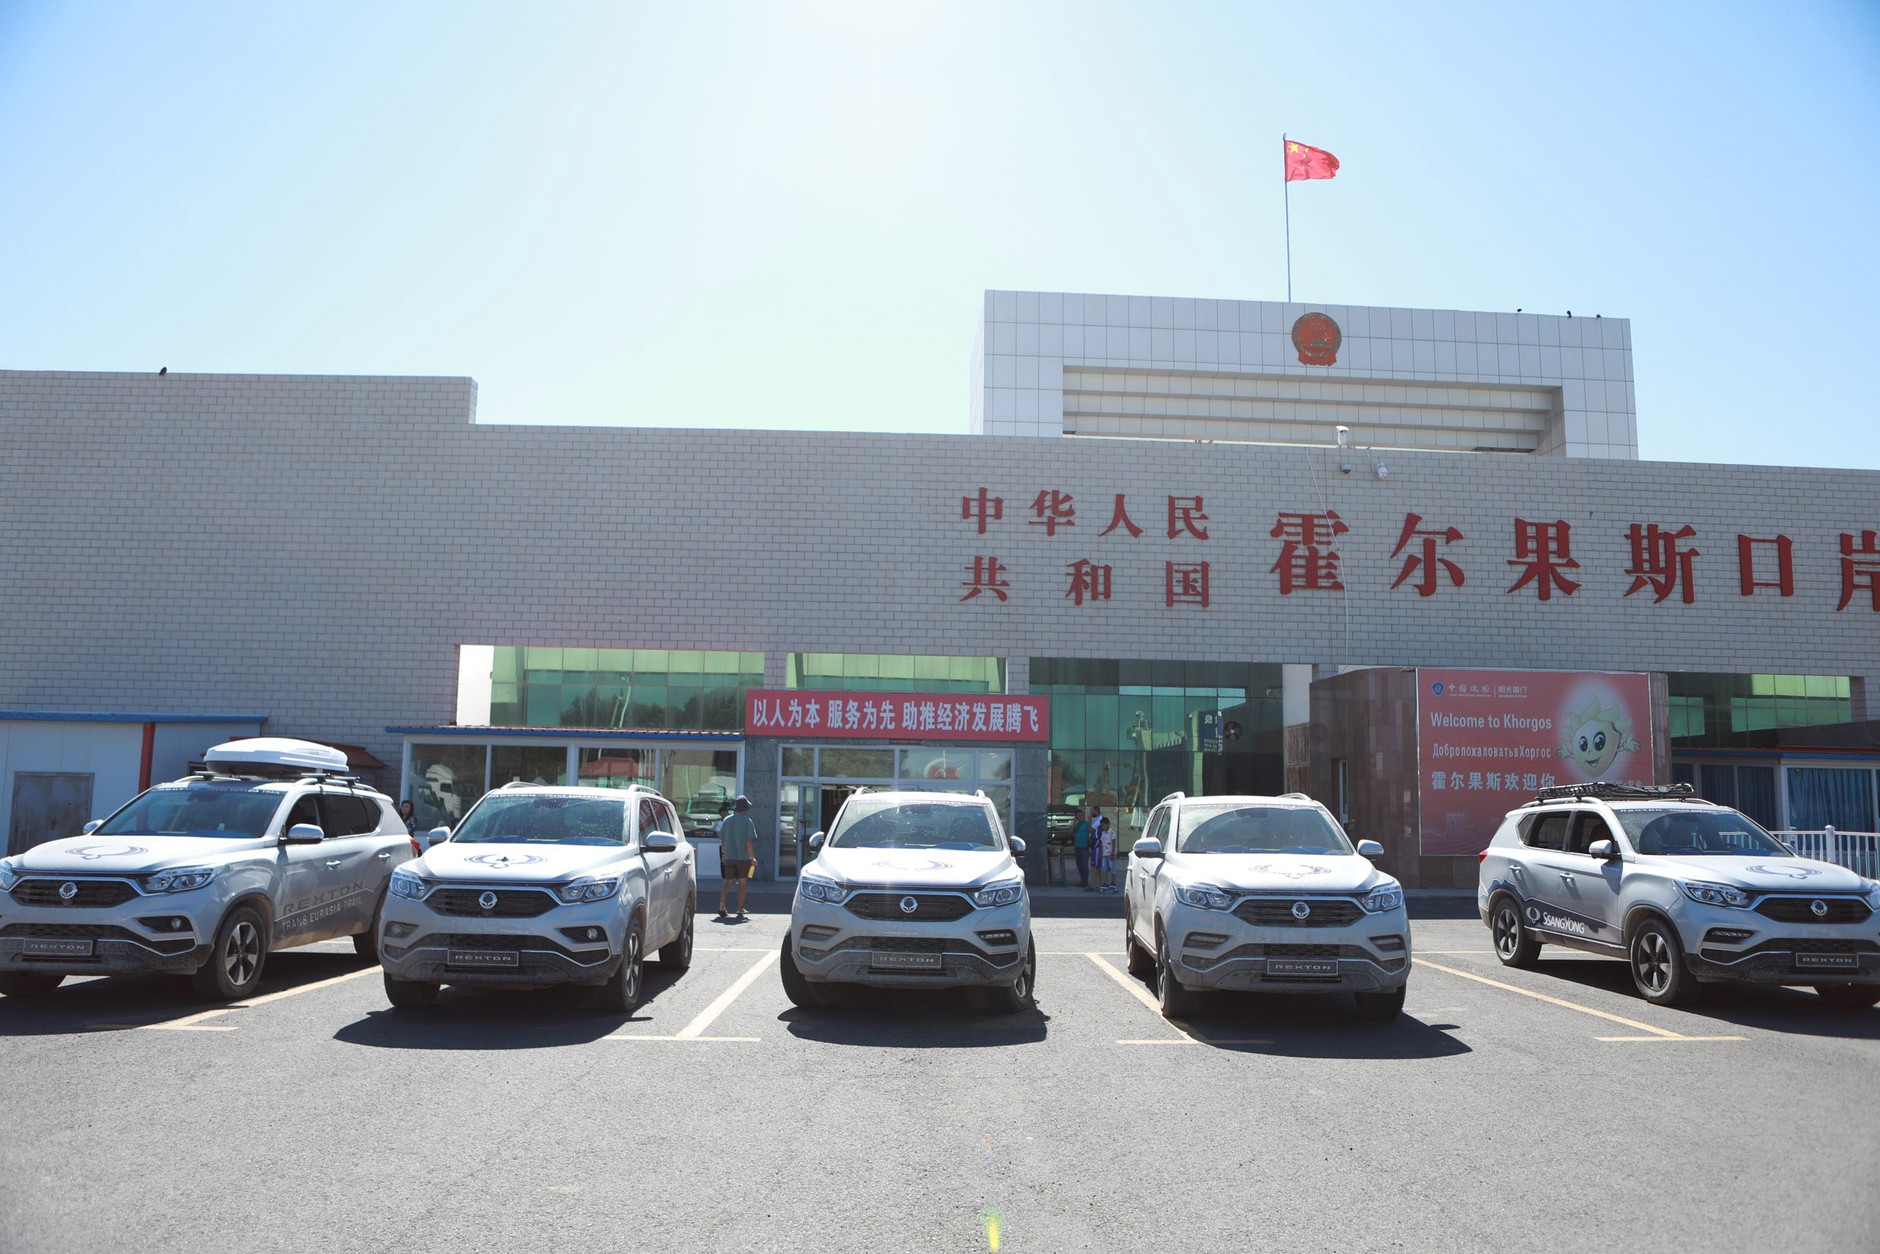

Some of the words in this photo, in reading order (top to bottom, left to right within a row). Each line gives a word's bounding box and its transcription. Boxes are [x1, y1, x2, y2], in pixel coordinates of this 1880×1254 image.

[962, 487, 1210, 540] 中华人民
[1270, 510, 1880, 612] 霍尔果斯口岸
[960, 556, 1210, 608] 共和国
[752, 698, 821, 729] 以人为本
[827, 699, 896, 731] 服务为先
[902, 702, 1039, 734] 助推经济发展腾飞
[1430, 712, 1485, 728] Welcome
[1487, 714, 1500, 728] to
[1503, 714, 1552, 732] Khorgos
[1431, 771, 1555, 791] 霍尔果斯欢迎你
[281, 915, 307, 932] TRANS
[309, 903, 341, 923] EURASIA
[343, 896, 362, 909] TRAIL
[283, 881, 364, 917] REXTON
